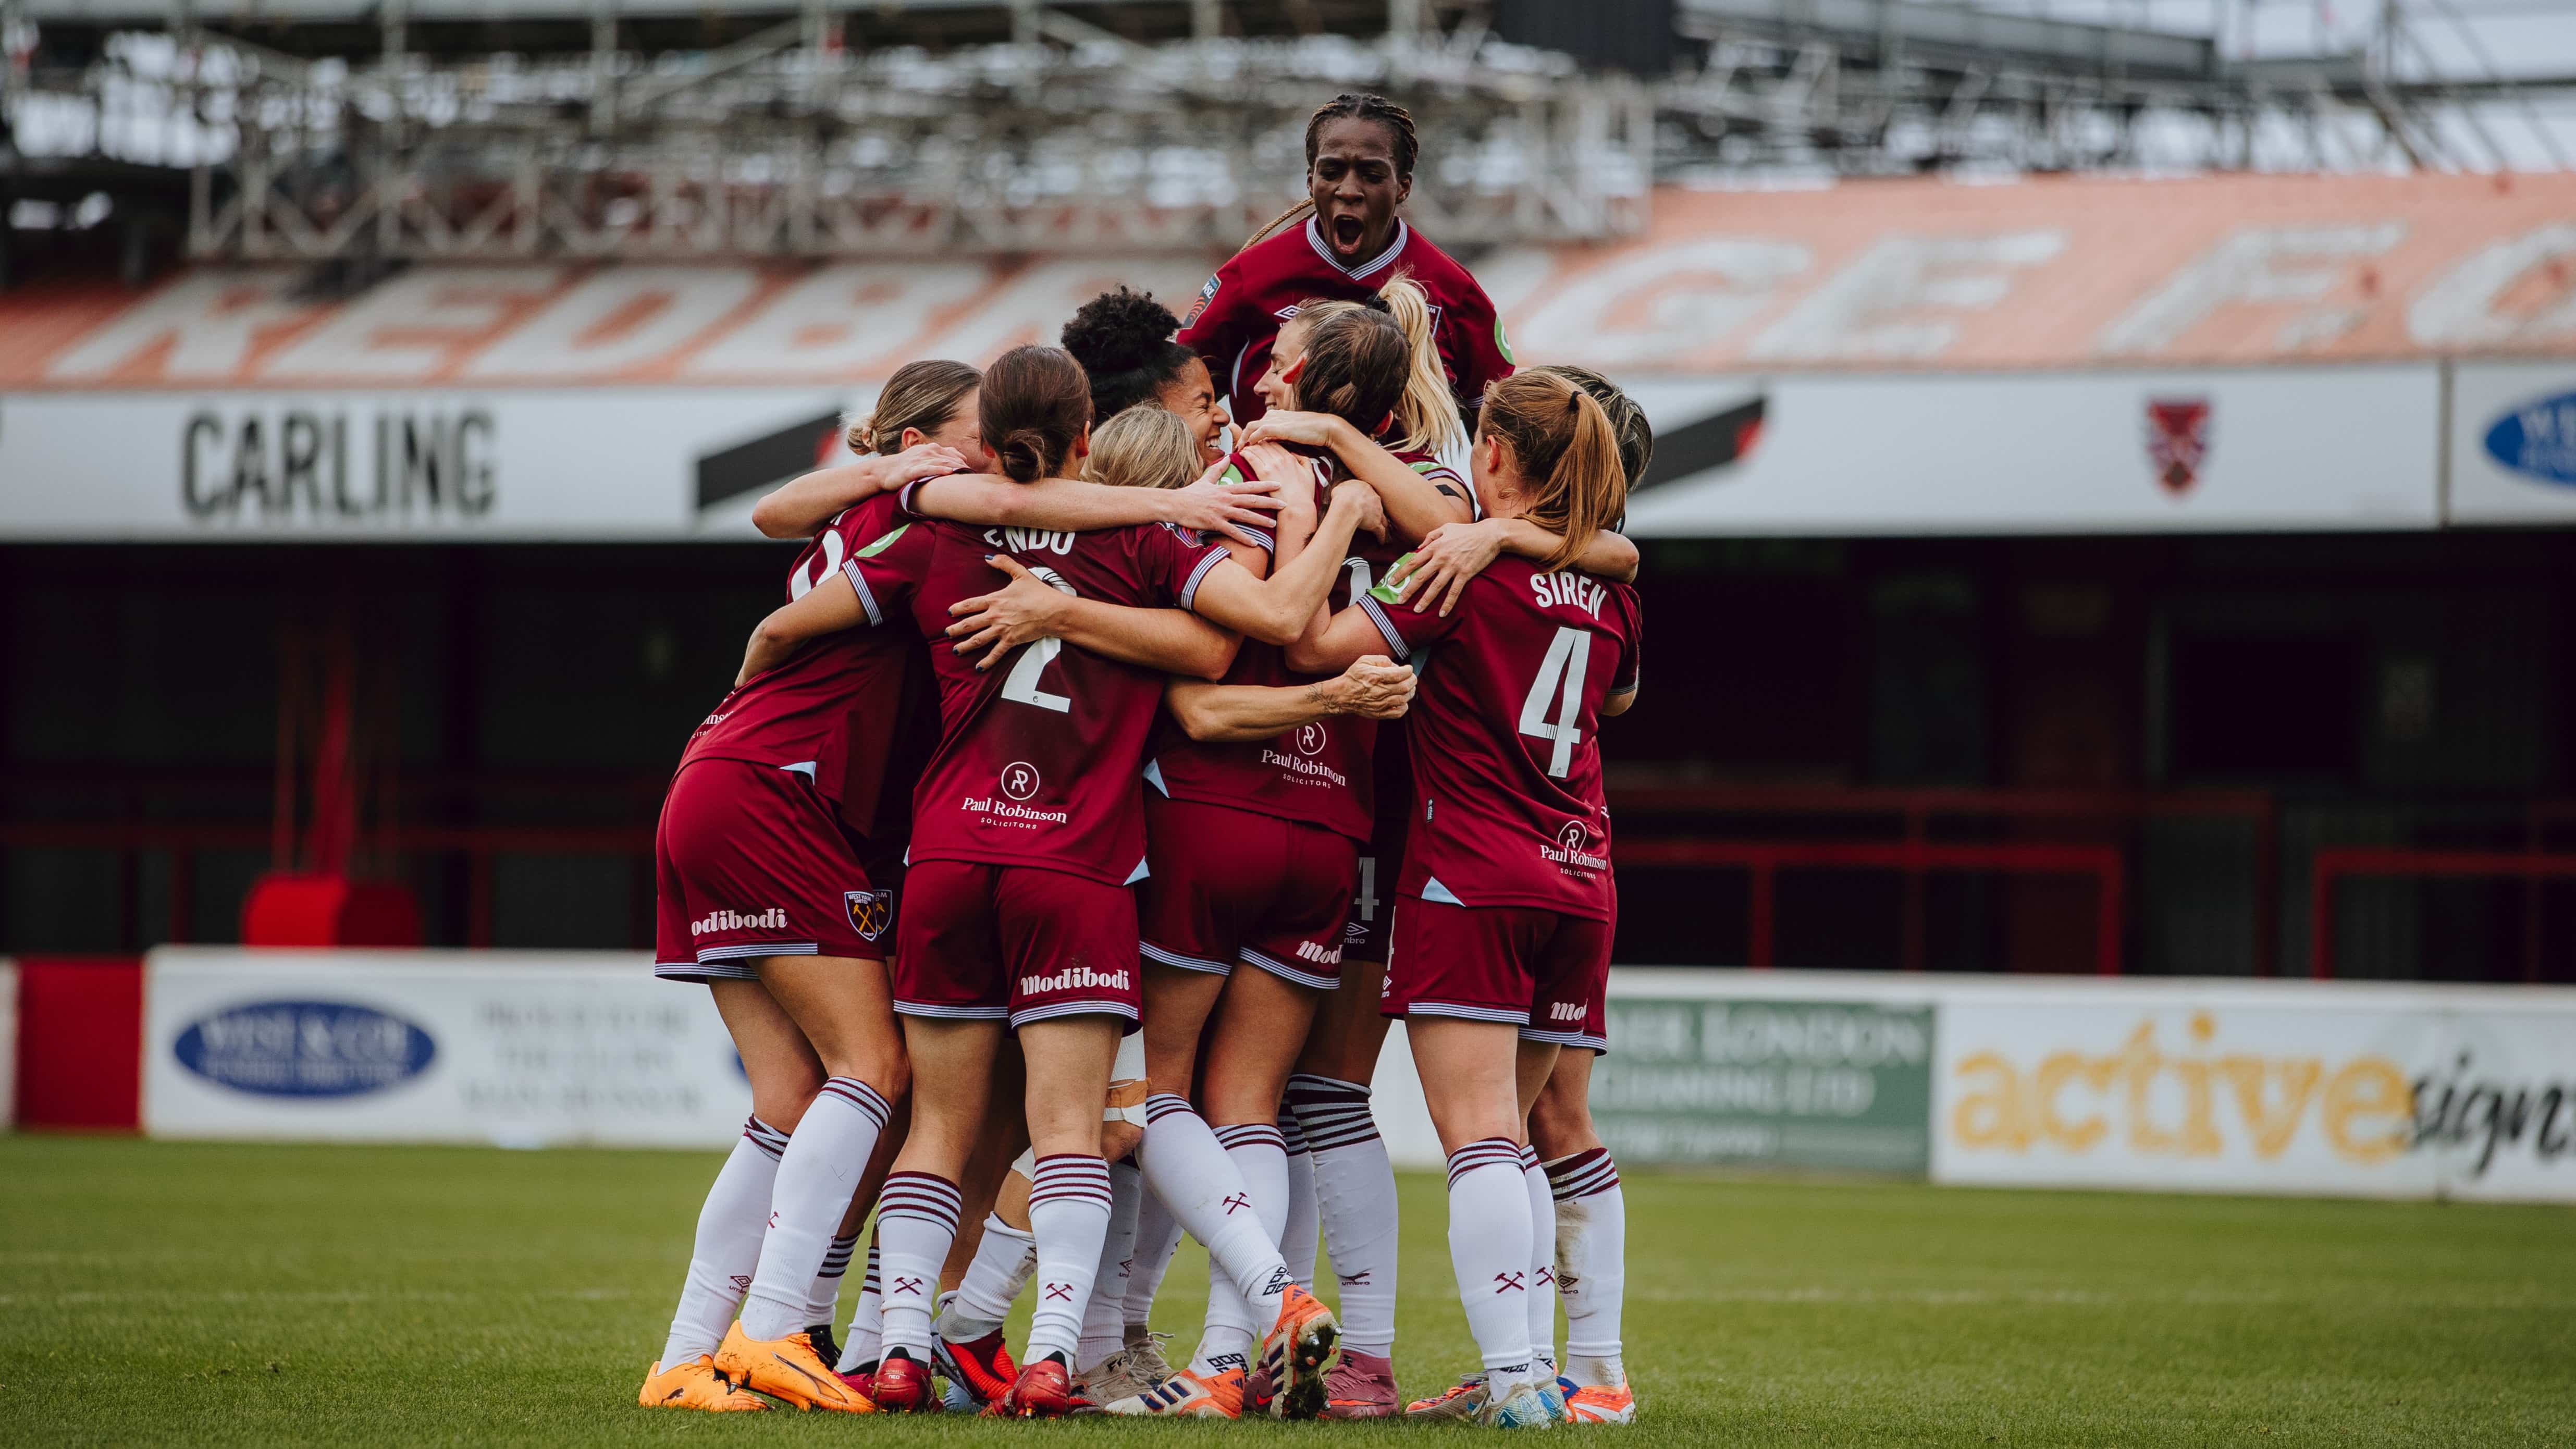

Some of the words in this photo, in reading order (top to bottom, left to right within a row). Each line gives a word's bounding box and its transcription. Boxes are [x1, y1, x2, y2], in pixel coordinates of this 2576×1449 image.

[180, 408, 499, 517] CARLING
[1530, 571, 1607, 621] SIREN
[1518, 626, 1592, 779] 4
[1261, 749, 1291, 768] Paul
[1292, 756, 1346, 787] Robinson
[1283, 773, 1331, 789] SOLICITORS
[961, 797, 992, 813] Paul
[993, 800, 1067, 824] Robinson
[980, 817, 1038, 830] SOLICITORS
[1539, 844, 1568, 863] Paul
[1569, 850, 1607, 870] Robinson
[1560, 868, 1596, 880] SOLICITORS
[691, 908, 787, 937] odibodi
[1021, 967, 1130, 996] Modibodi
[1952, 1010, 2414, 1166] active
